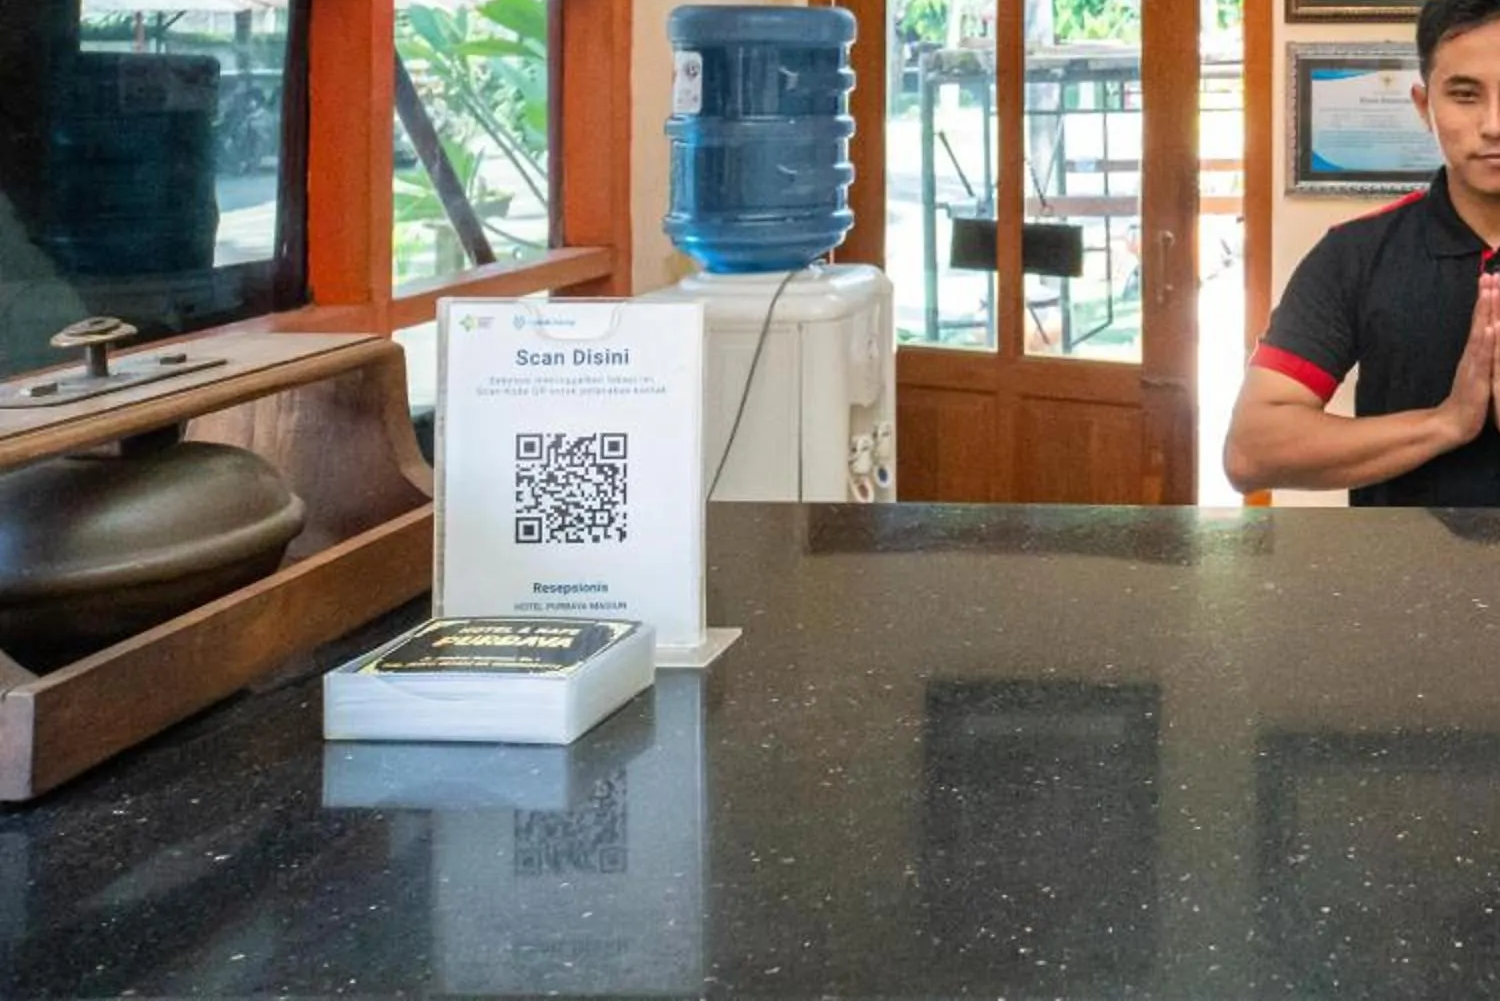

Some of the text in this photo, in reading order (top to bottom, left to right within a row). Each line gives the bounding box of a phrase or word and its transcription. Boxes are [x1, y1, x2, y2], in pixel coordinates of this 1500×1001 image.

[516, 348, 630, 366] Scan Disini
[533, 582, 609, 595] Resepsionis
